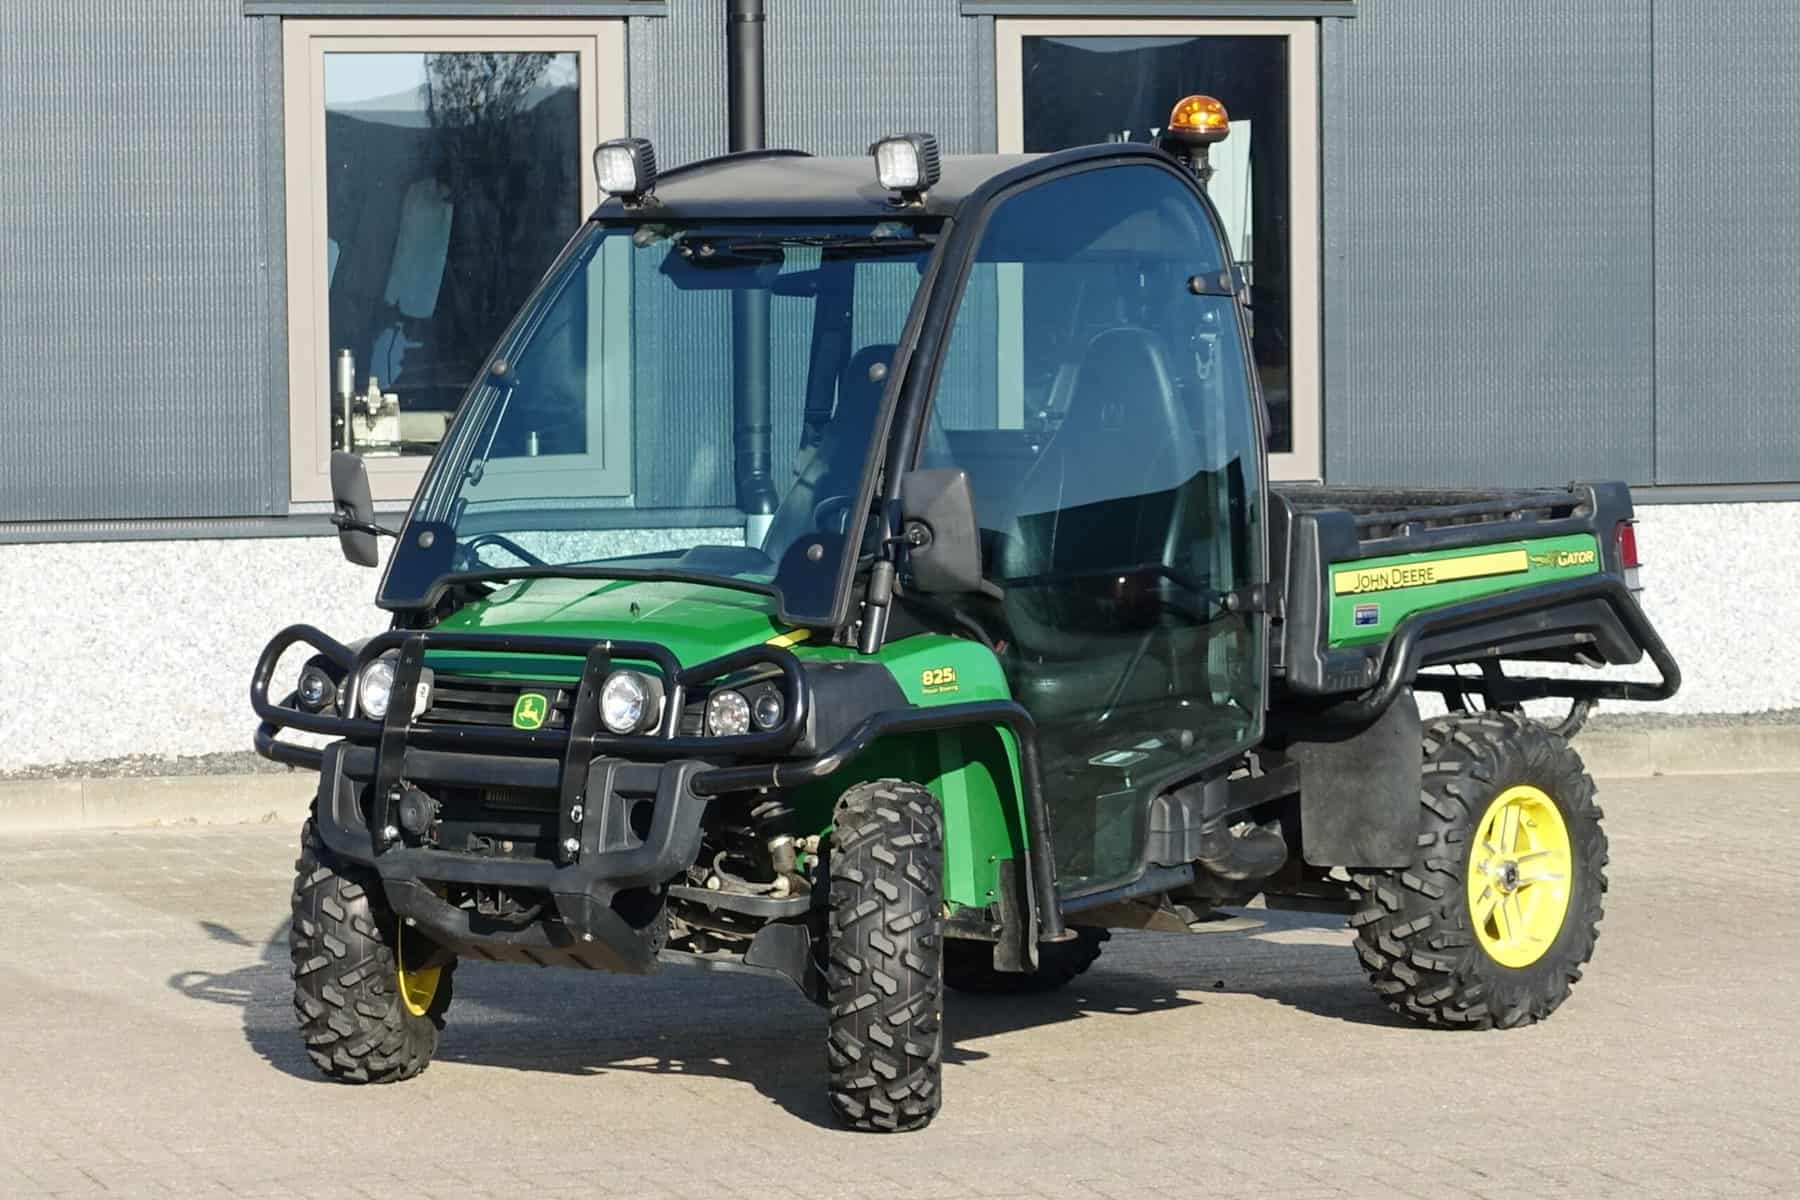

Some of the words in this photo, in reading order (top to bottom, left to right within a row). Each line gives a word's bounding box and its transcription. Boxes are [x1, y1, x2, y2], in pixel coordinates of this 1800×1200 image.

[1558, 550, 1594, 566] GATOR
[1353, 572, 1390, 590] JOHN
[1391, 567, 1434, 585] DEERE
